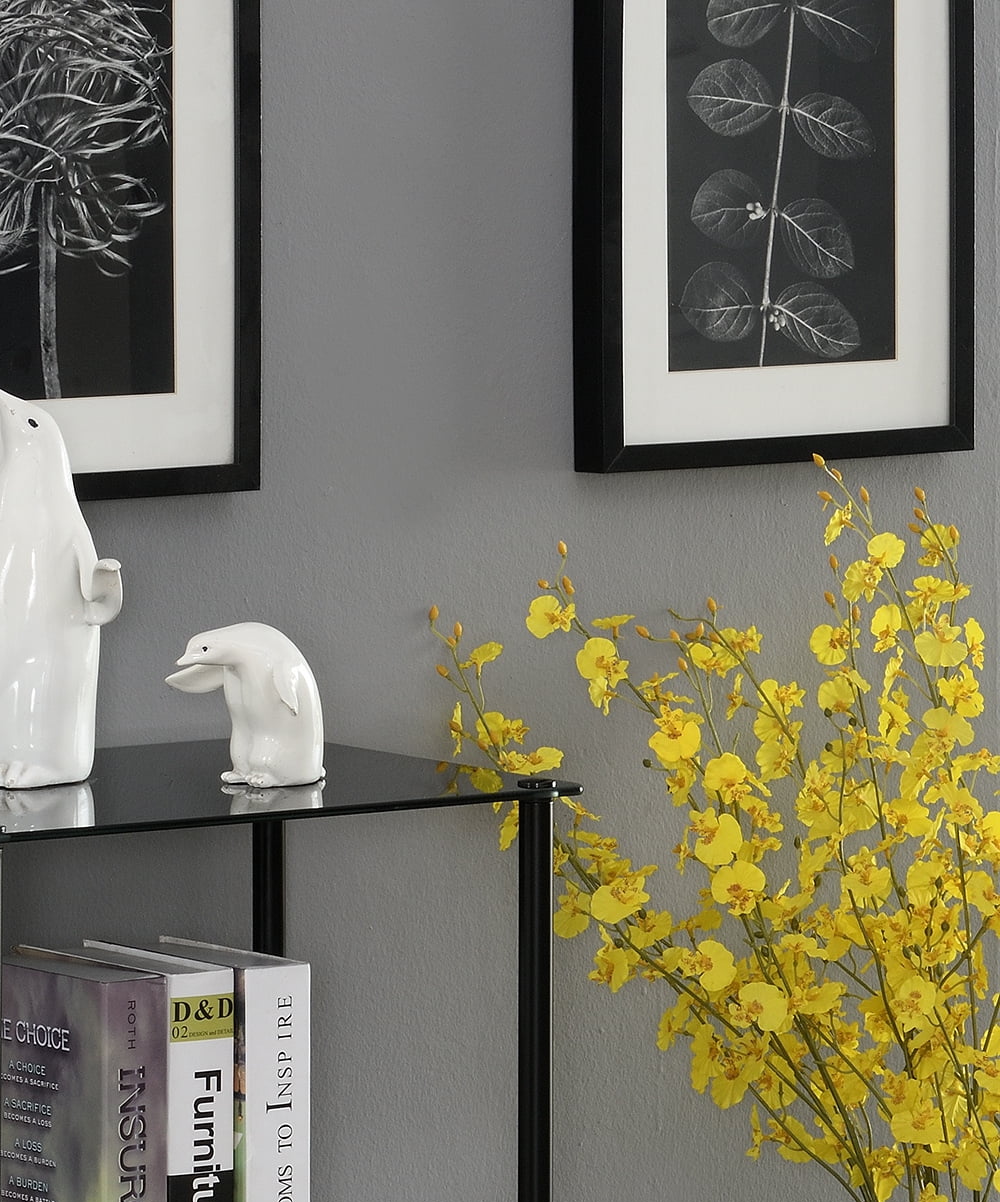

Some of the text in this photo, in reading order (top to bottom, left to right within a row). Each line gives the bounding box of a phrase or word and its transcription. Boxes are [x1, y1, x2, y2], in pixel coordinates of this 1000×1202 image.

[127, 1000, 137, 1050] ROTH
[171, 1025, 188, 1039] 02
[15, 1020, 71, 1052] CHOICE
[8, 1059, 47, 1076] A CHOICE
[3, 1097, 52, 1116] A SACRIFICE
[37, 1119, 52, 1128] LOSS
[14, 1138, 43, 1153] A LOSS
[8, 1175, 49, 1193] A BURDEN
